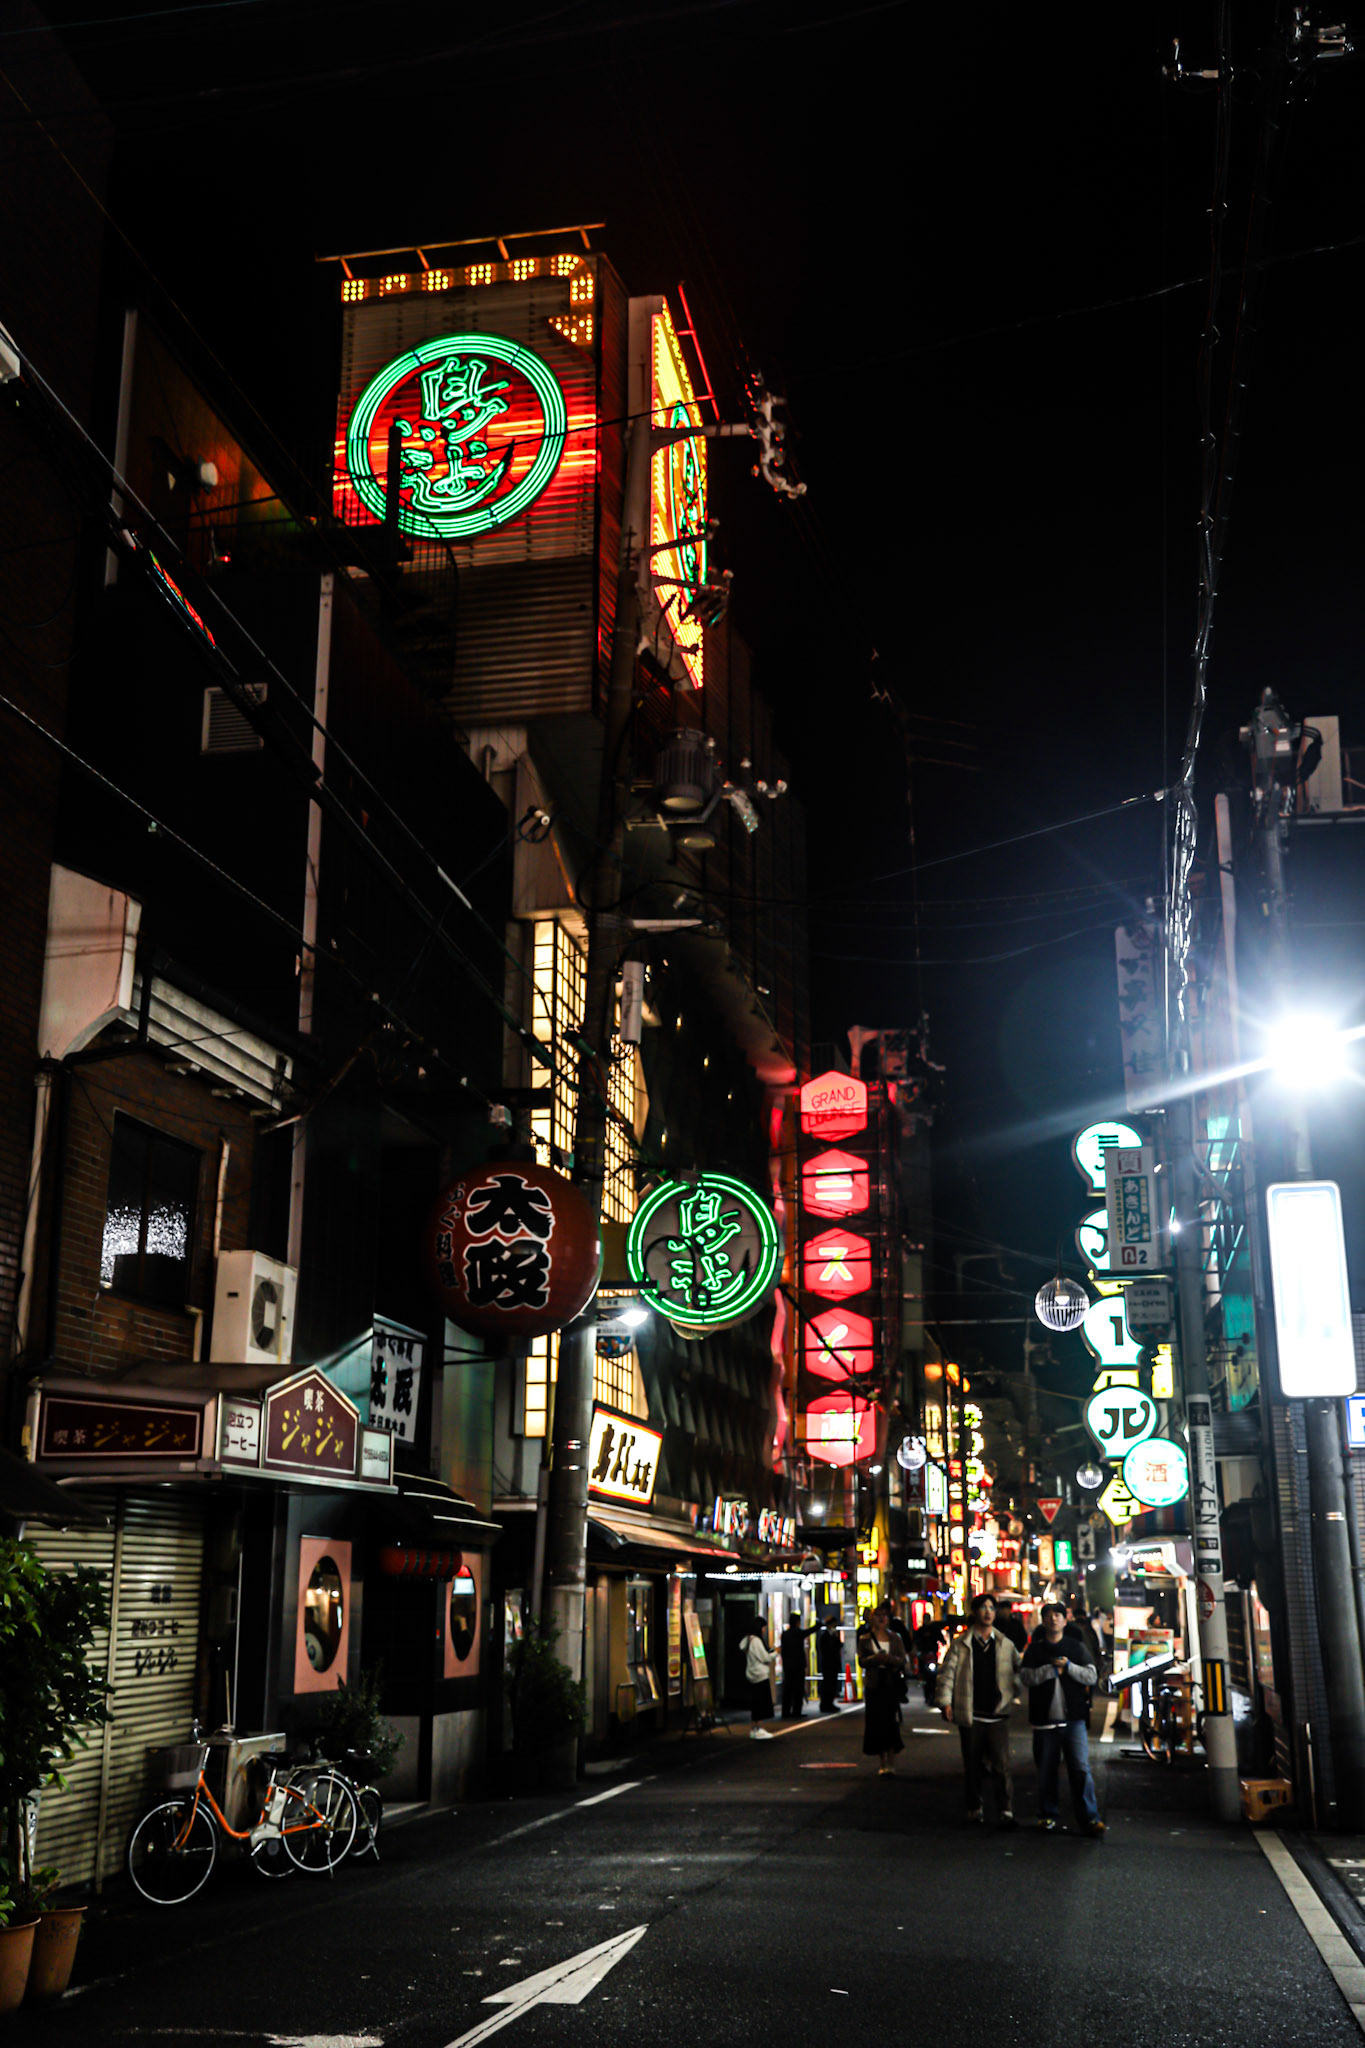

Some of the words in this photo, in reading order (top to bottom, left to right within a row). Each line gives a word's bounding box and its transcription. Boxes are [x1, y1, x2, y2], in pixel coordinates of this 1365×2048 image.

[811, 1086, 856, 1109] GRAND
[1118, 1151, 1141, 1174] 質
[1123, 1179, 1142, 1242] あきんど
[1138, 1250, 1147, 1264] 2
[303, 1387, 324, 1413] 喫茶
[91, 1420, 188, 1449] ジャジャ
[223, 1434, 257, 1451] コーヒー
[281, 1409, 344, 1460] ジャジャ
[1204, 1430, 1213, 1465] HOTEL
[1145, 1462, 1168, 1483] 酒
[1200, 1482, 1217, 1525] ZEN
